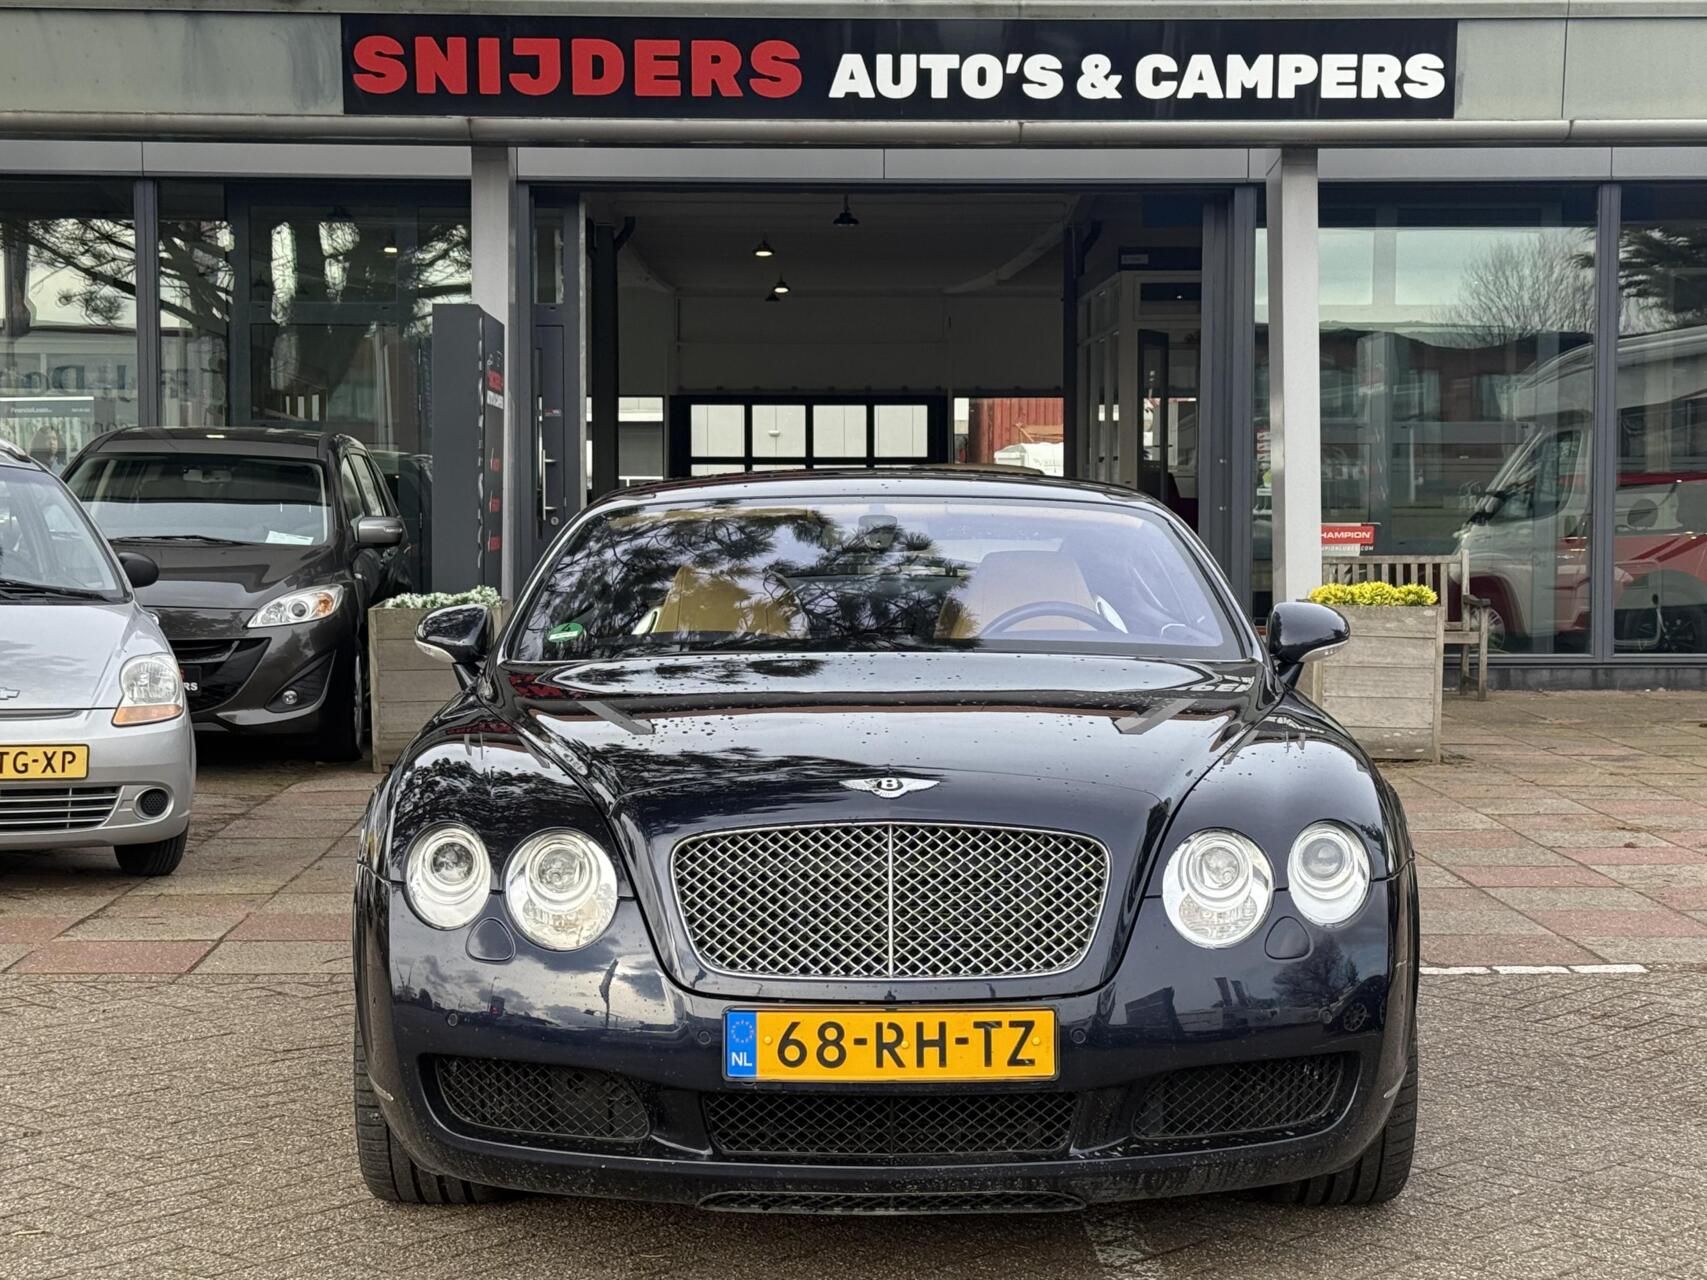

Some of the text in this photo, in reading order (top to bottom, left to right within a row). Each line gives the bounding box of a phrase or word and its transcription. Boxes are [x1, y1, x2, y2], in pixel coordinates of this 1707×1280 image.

[352, 34, 1446, 100] SNIJDERS AUTO'S & CAMPERS
[1321, 531, 1370, 539] HAMPION
[183, 682, 198, 691] RS
[777, 1020, 1036, 1069] 68-RH-TZ
[731, 1052, 753, 1067] NL
